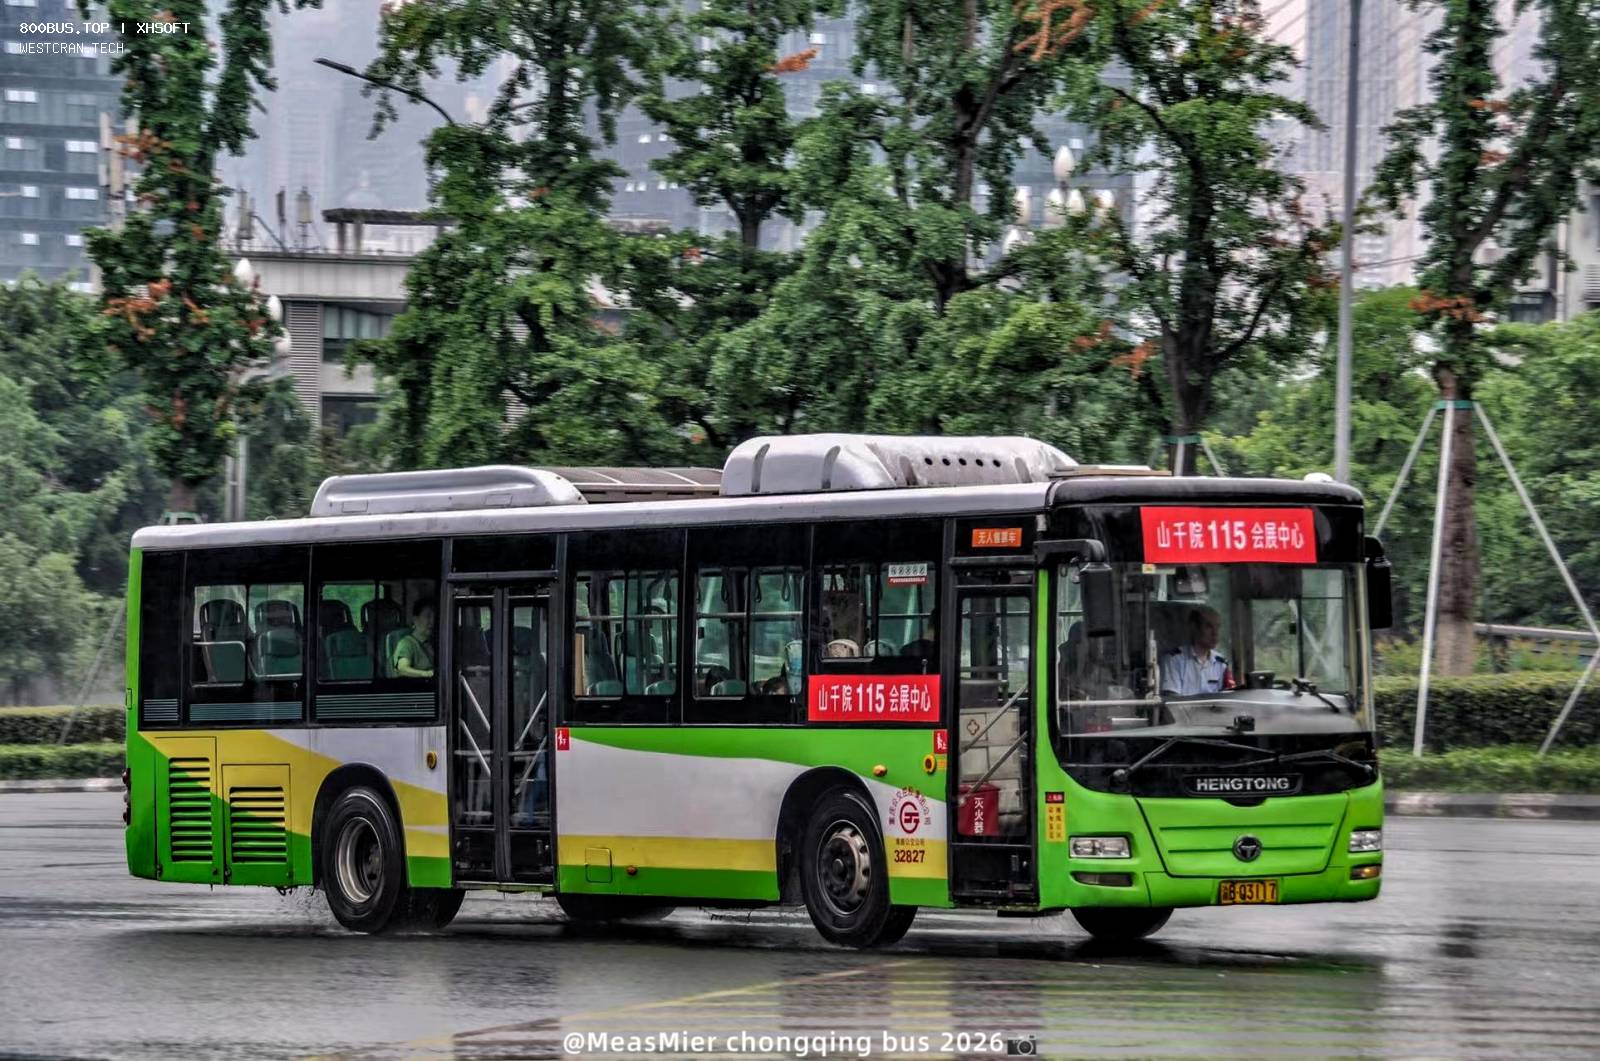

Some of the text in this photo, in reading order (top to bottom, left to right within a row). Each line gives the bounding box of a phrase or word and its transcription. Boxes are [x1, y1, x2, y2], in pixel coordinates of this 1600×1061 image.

[1156, 520, 1305, 549] 山千院 115 会展中心
[818, 683, 931, 713] 山千院 115 会展中心
[1196, 777, 1290, 791] HENGTONG
[974, 797, 985, 833] 灭火器
[894, 849, 926, 863] 32827
